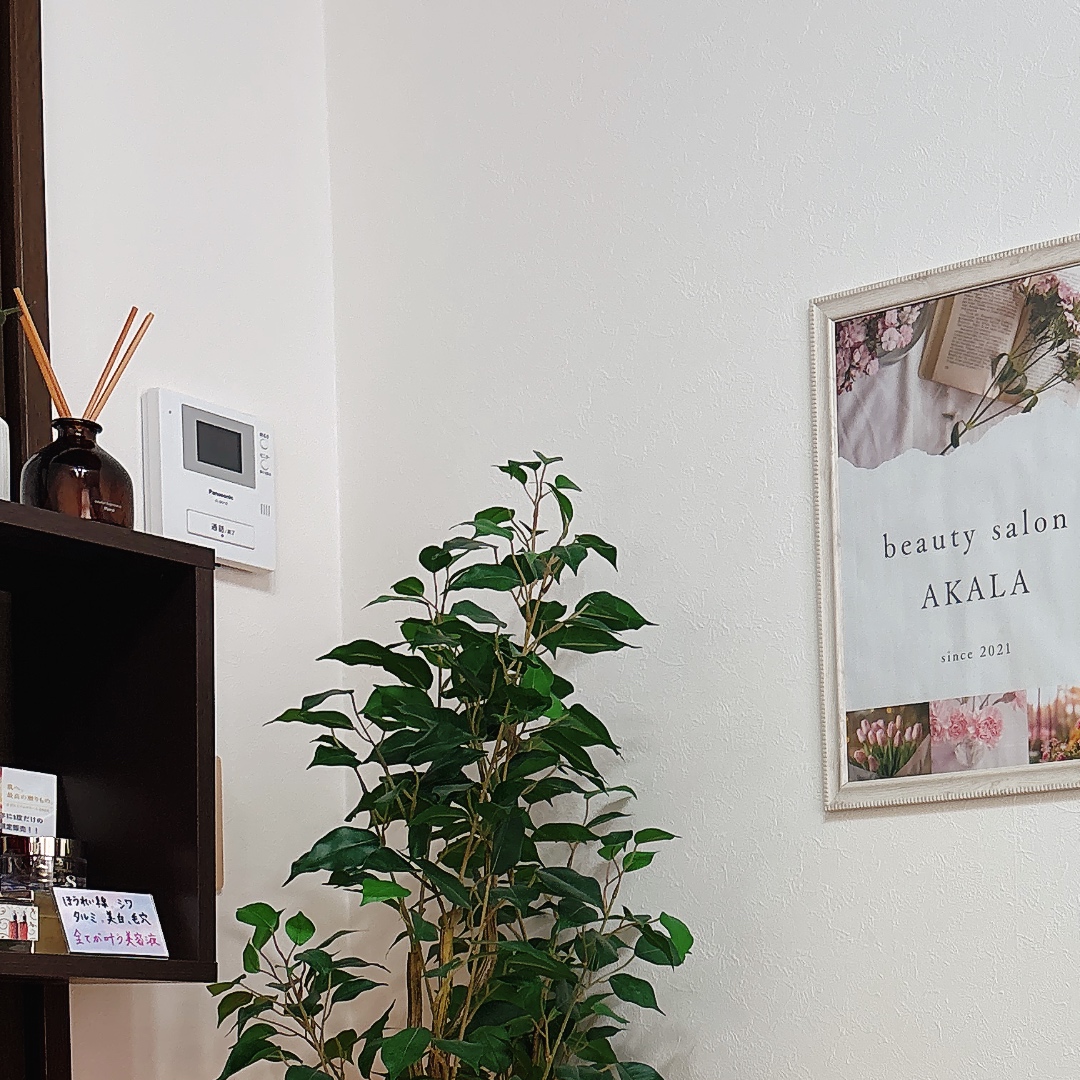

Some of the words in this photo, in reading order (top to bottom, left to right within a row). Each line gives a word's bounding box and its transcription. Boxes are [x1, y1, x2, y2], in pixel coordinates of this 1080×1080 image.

[882, 529, 976, 559] beauty
[991, 508, 1068, 541] salon
[921, 569, 1030, 610] AKALA
[940, 650, 974, 663] since
[980, 642, 1011, 658] 2021
[74, 928, 160, 948] 全てが叶う美容液
